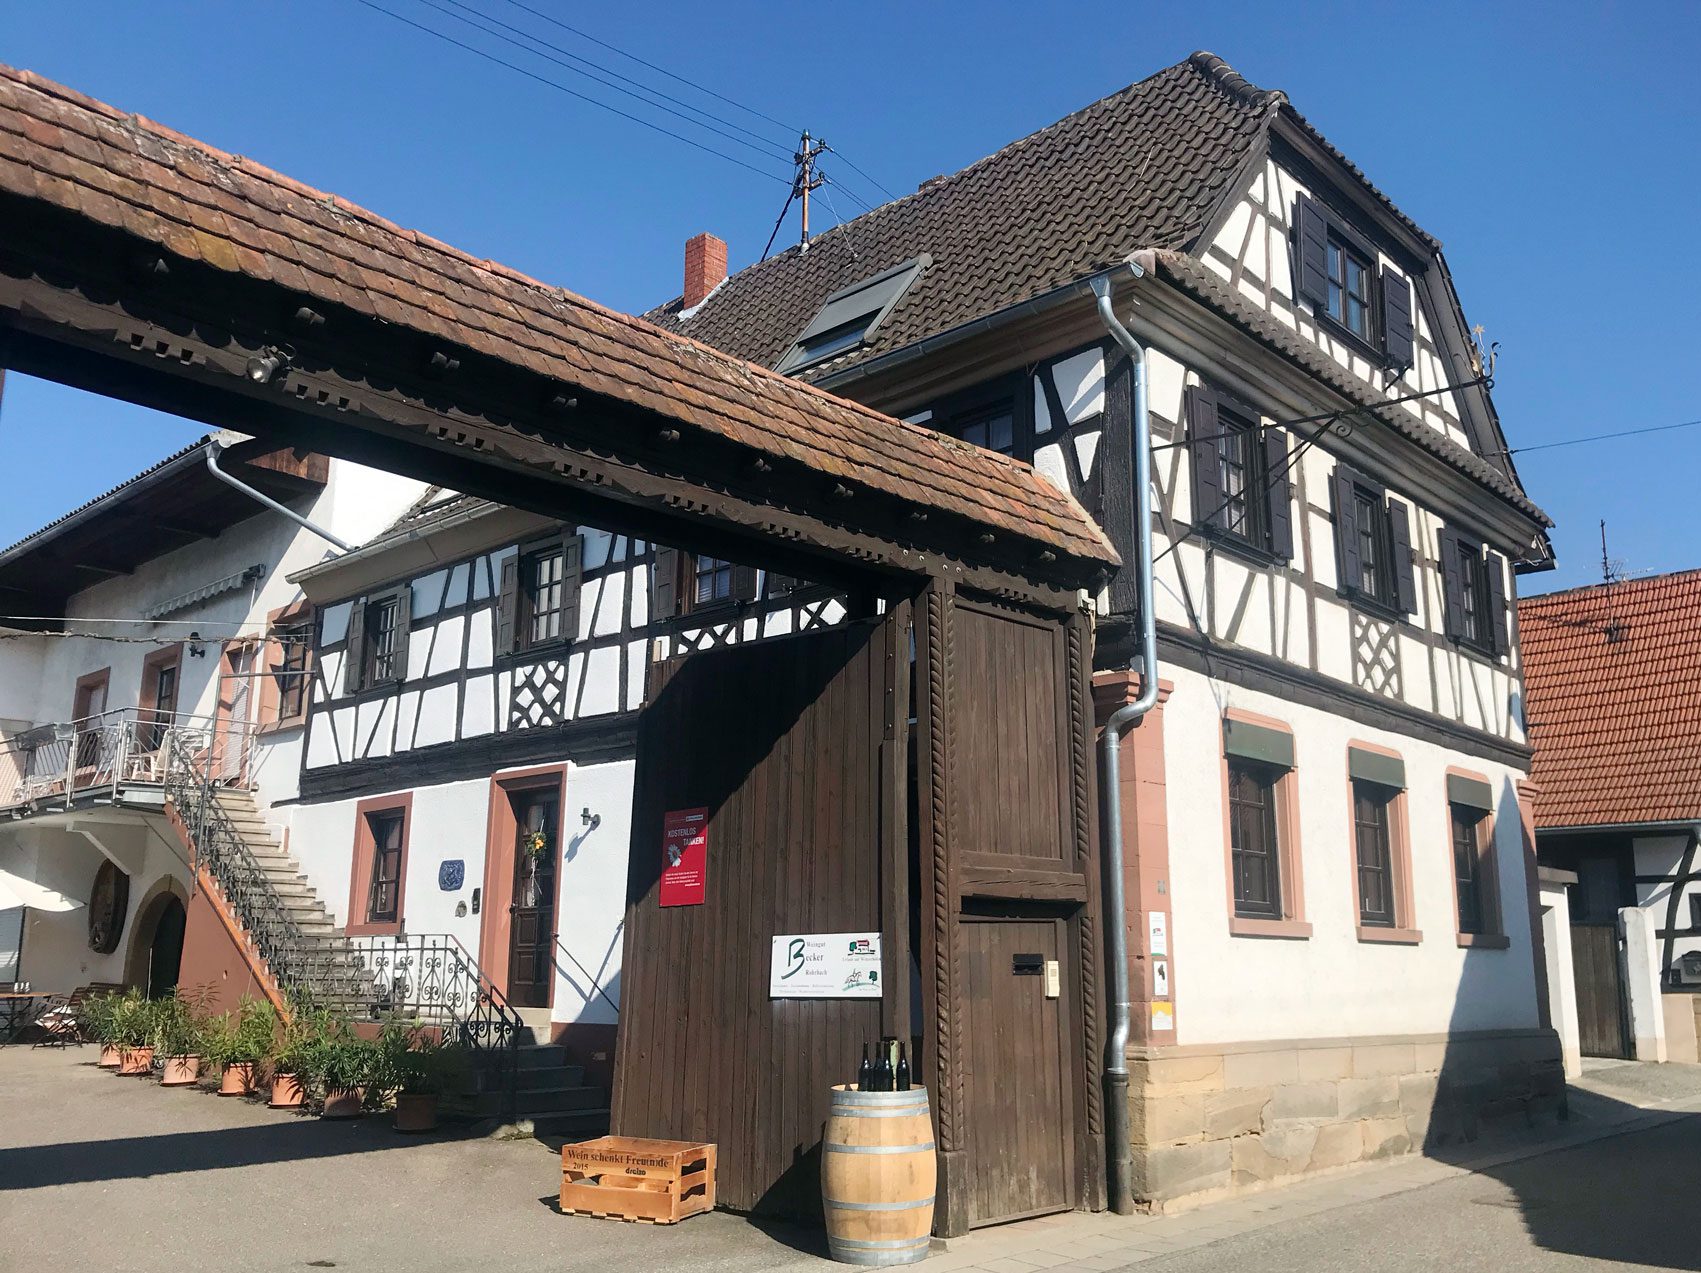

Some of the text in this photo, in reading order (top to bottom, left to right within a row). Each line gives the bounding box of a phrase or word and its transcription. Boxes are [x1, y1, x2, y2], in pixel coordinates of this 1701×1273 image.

[667, 827, 696, 838] KOSTENLOS
[781, 938, 824, 980] Becker
[567, 1149, 589, 1161] Wein
[590, 1152, 624, 1164] schenkt
[573, 1162, 589, 1171] 2015
